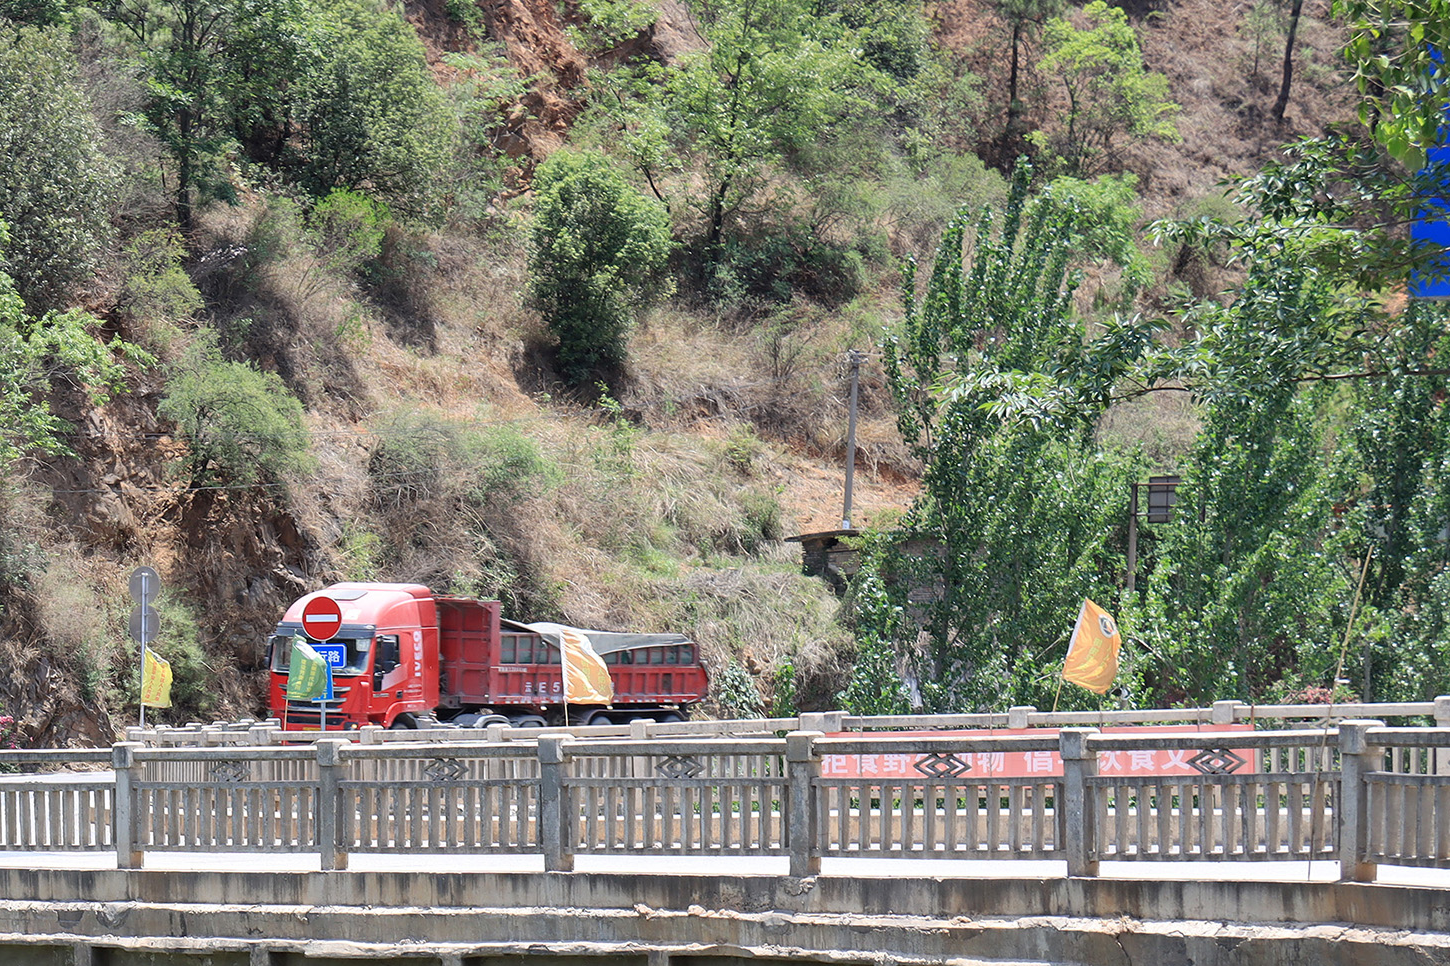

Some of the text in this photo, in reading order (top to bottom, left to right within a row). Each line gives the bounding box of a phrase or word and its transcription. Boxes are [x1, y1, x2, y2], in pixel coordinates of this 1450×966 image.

[413, 631, 423, 677] IVECO
[821, 752, 1005, 775] 拒食野物
